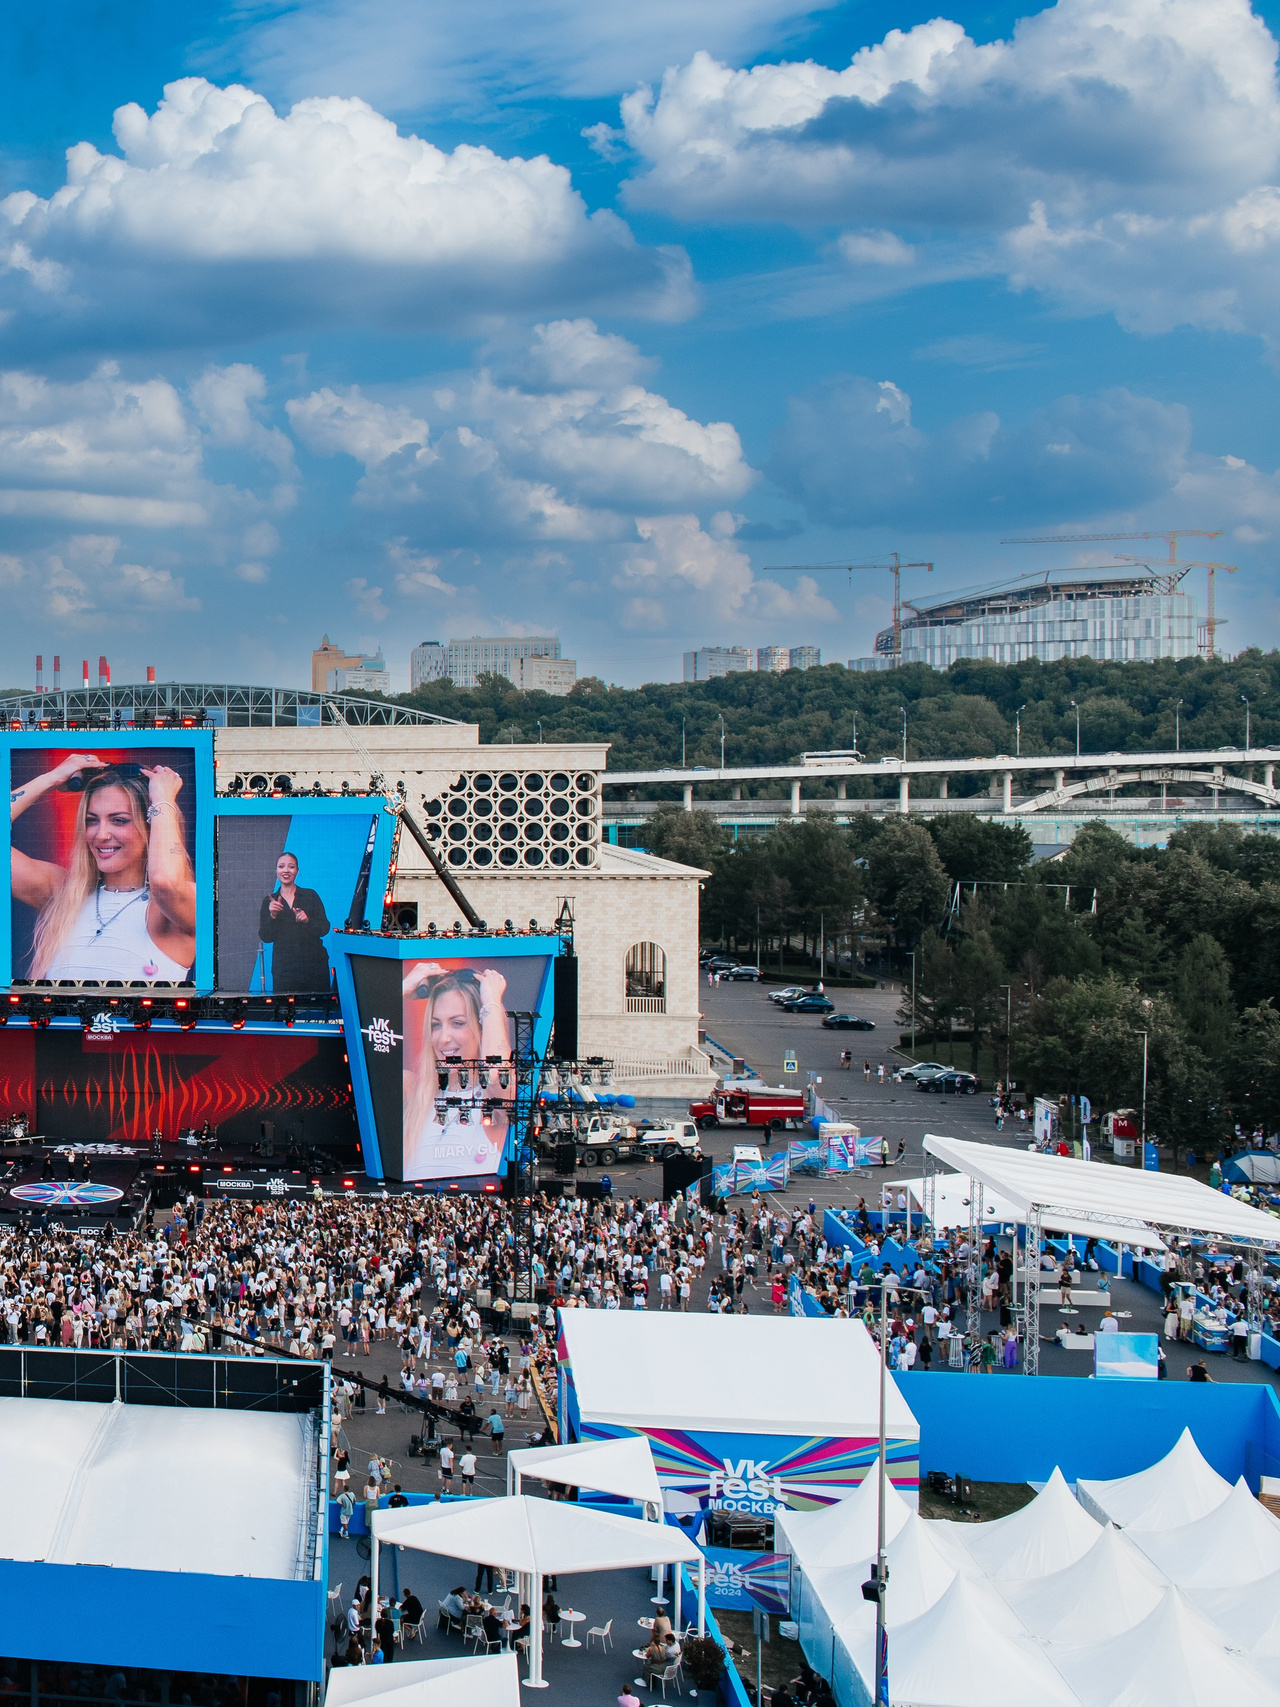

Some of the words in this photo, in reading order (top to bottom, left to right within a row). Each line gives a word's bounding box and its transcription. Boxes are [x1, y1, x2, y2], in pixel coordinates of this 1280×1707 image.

[84, 1020, 121, 1033] est
[372, 1017, 390, 1032] VK
[367, 1024, 397, 1047] fest
[373, 1043, 390, 1053] 2024
[434, 1144, 474, 1158] MARY
[477, 1142, 498, 1155] GU
[266, 1181, 290, 1191] fest
[722, 1458, 771, 1480] VK
[708, 1470, 789, 1501] fest
[708, 1498, 787, 1514] МОСКВА
[714, 1561, 744, 1576] VK
[704, 1569, 755, 1589] fest
[714, 1587, 742, 1597] 2024
